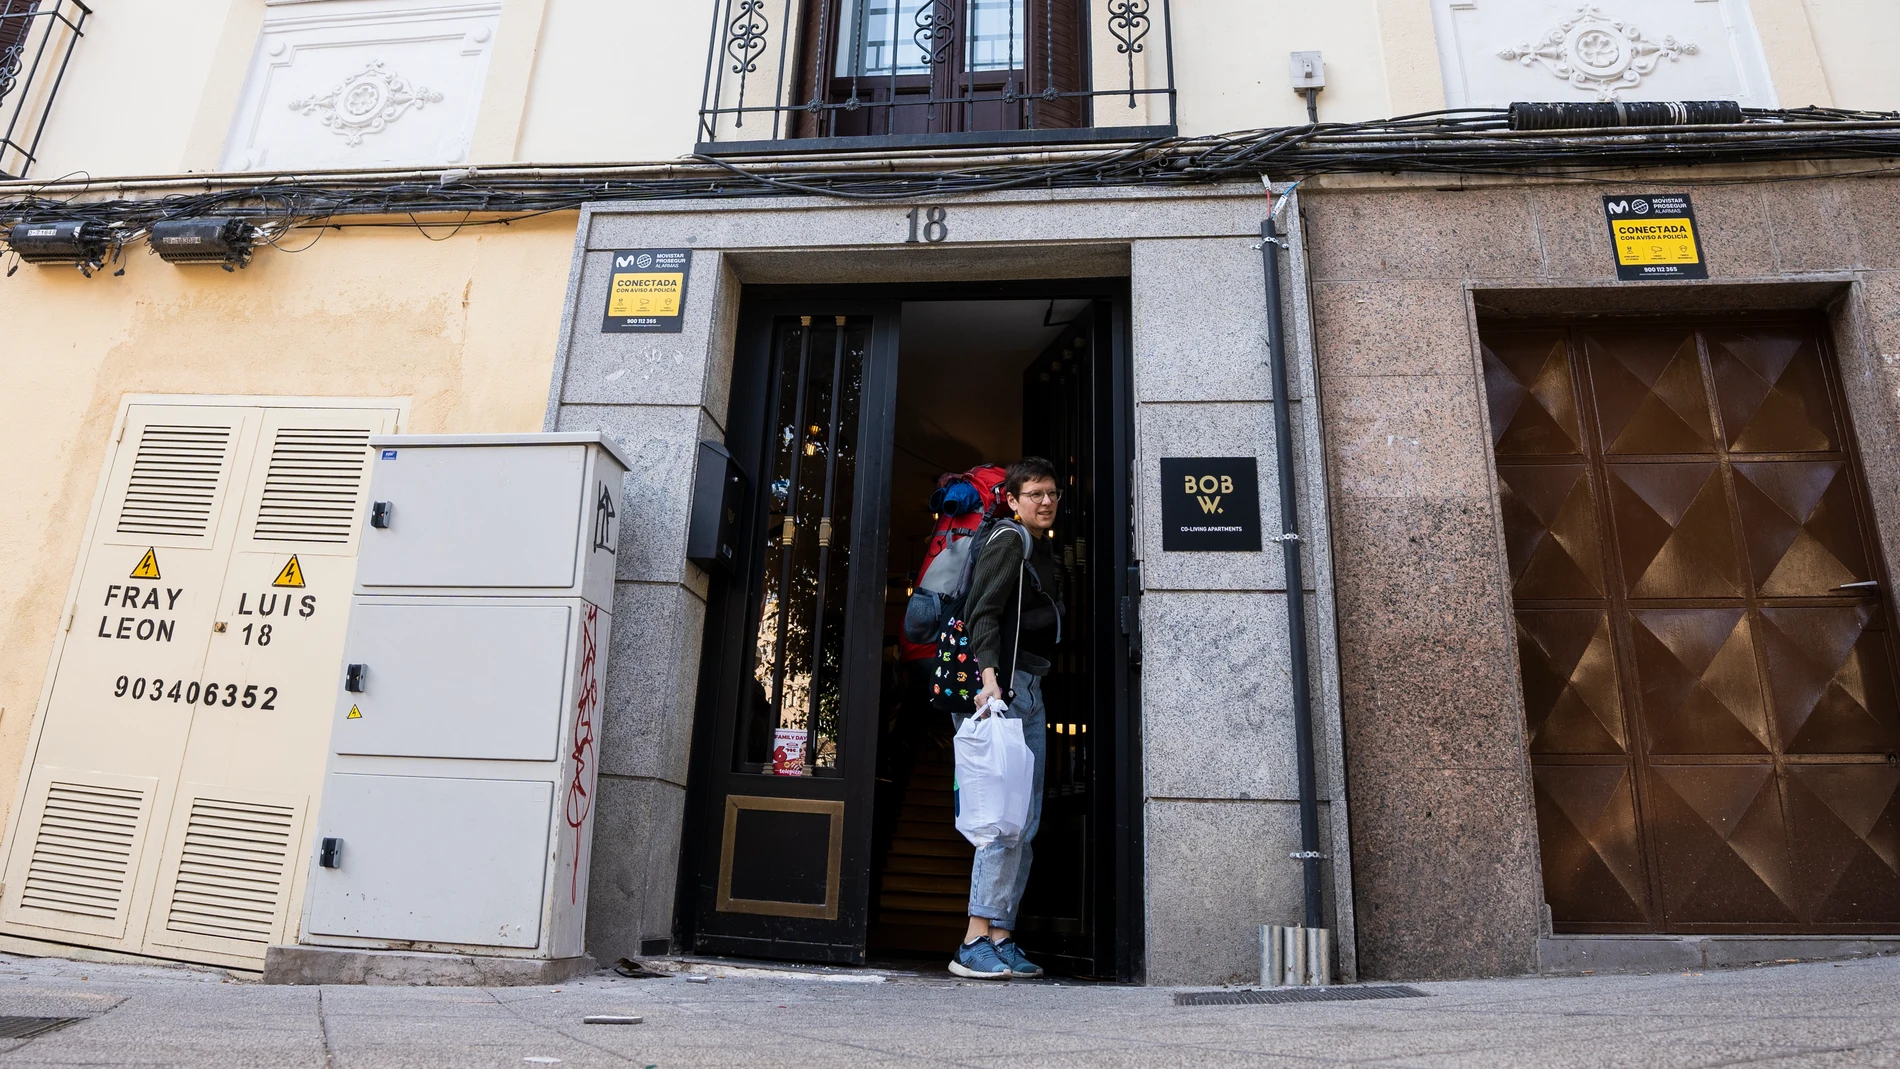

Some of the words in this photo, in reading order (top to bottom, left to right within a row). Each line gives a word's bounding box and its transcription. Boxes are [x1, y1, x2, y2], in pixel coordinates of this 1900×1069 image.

[905, 205, 948, 243] 18
[1618, 225, 1687, 234] CONECTADA
[617, 279, 678, 287] CONECTADA
[1184, 475, 1234, 494] BOB
[1196, 495, 1224, 515] W.
[104, 584, 183, 610] FRAY
[238, 592, 317, 619] LUIS
[98, 615, 176, 643] LEON
[241, 623, 273, 647] 18
[114, 675, 278, 711] 903406352
